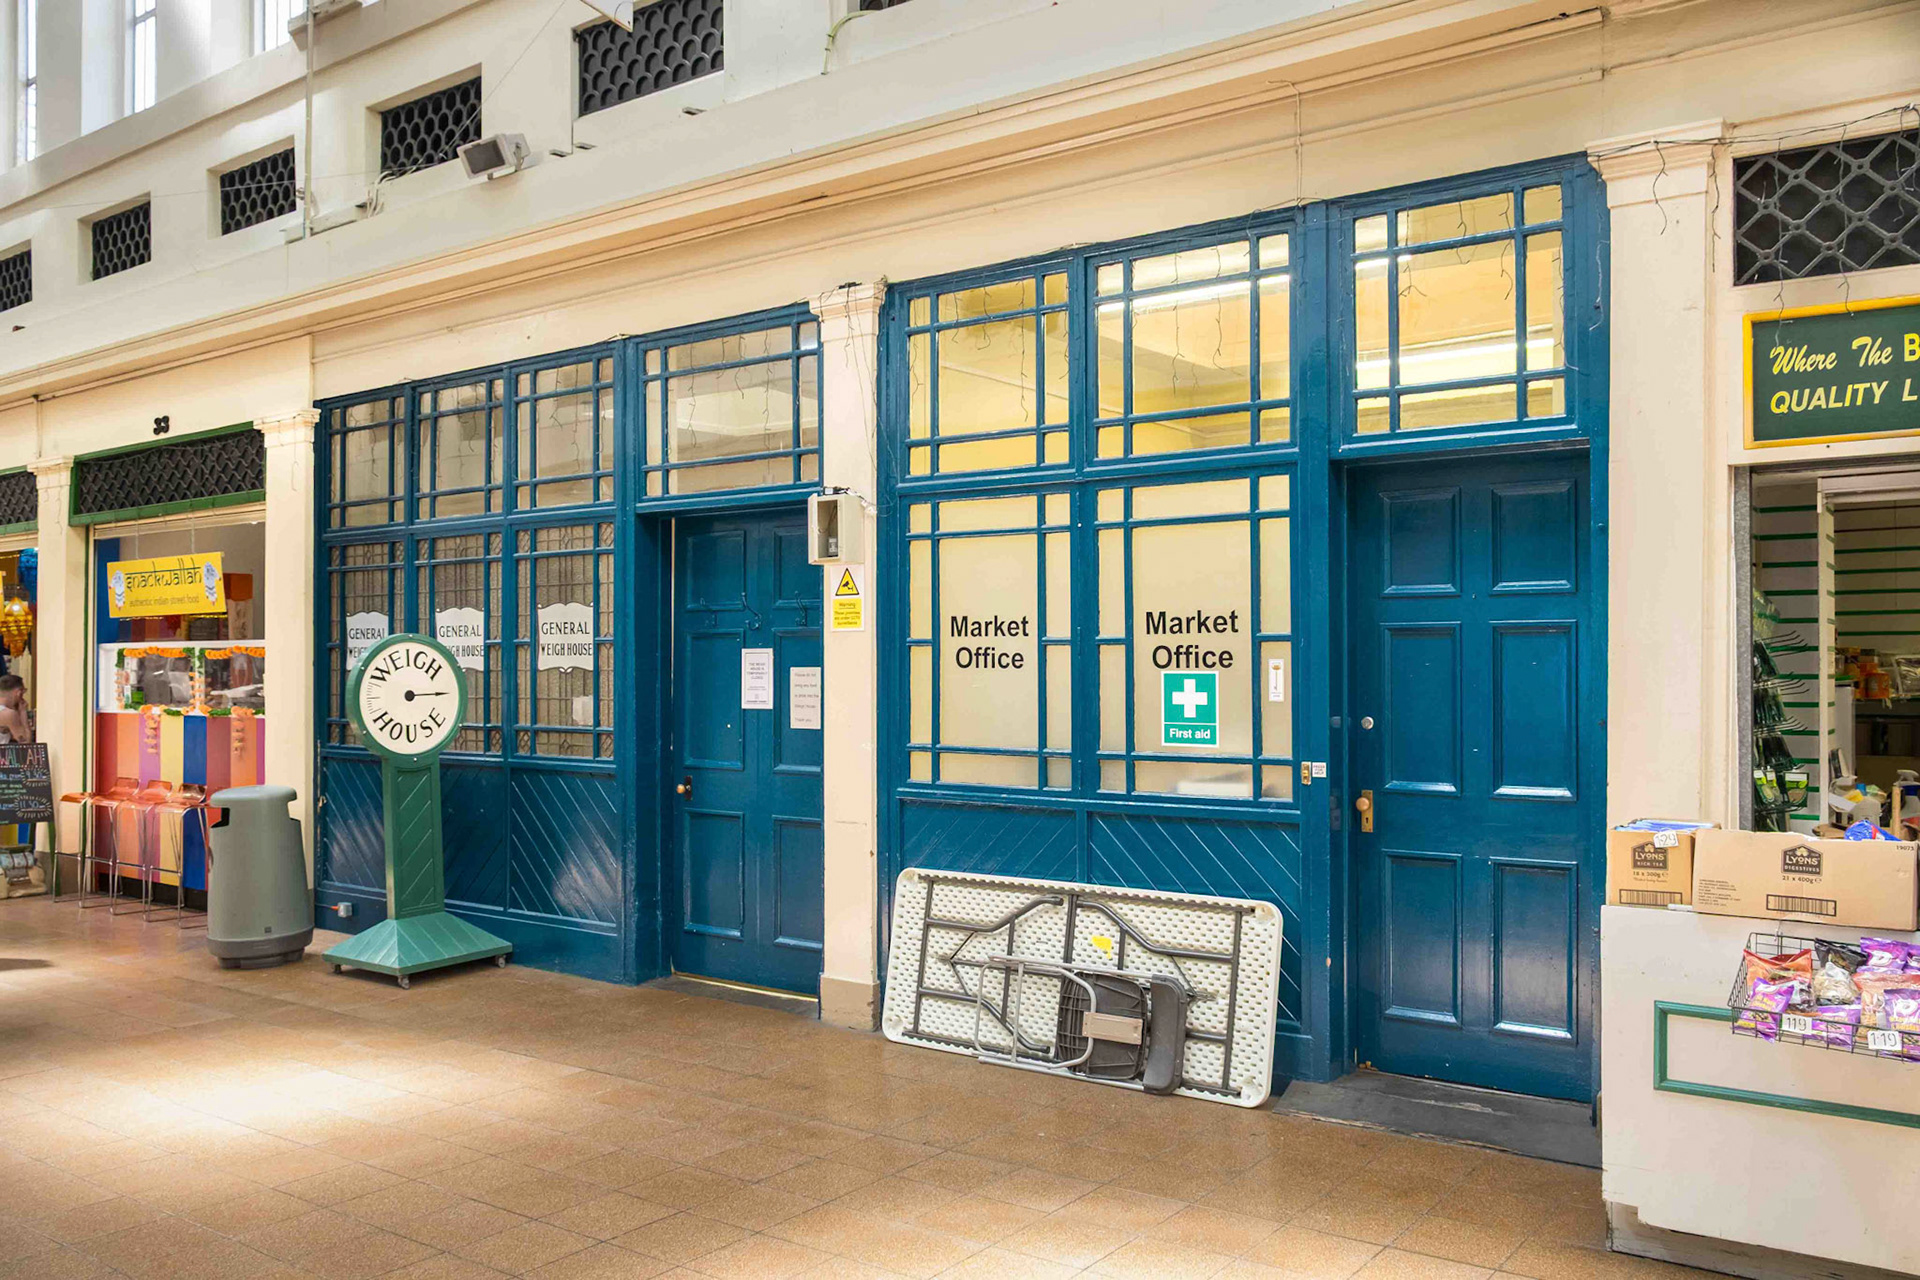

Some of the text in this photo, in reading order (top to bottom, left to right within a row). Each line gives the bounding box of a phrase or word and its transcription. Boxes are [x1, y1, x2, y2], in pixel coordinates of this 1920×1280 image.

[1769, 344, 1837, 375] Where
[1851, 336, 1893, 367] The
[1770, 378, 1918, 414] QUALITY L
[439, 624, 482, 638] GENERAL
[541, 621, 590, 635] GENERAL
[950, 615, 1029, 637] Market
[1145, 610, 1239, 635] Market
[461, 645, 484, 657] HOUSE
[541, 643, 592, 656] WEIGH HOUSE
[955, 647, 1024, 669] Office
[1152, 645, 1234, 669] Office
[370, 648, 443, 683] WEIGH
[372, 707, 446, 743] HOUSE
[1169, 728, 1211, 739] First aid
[1635, 851, 1665, 861] LYONS
[1785, 854, 1819, 866] LYONS
